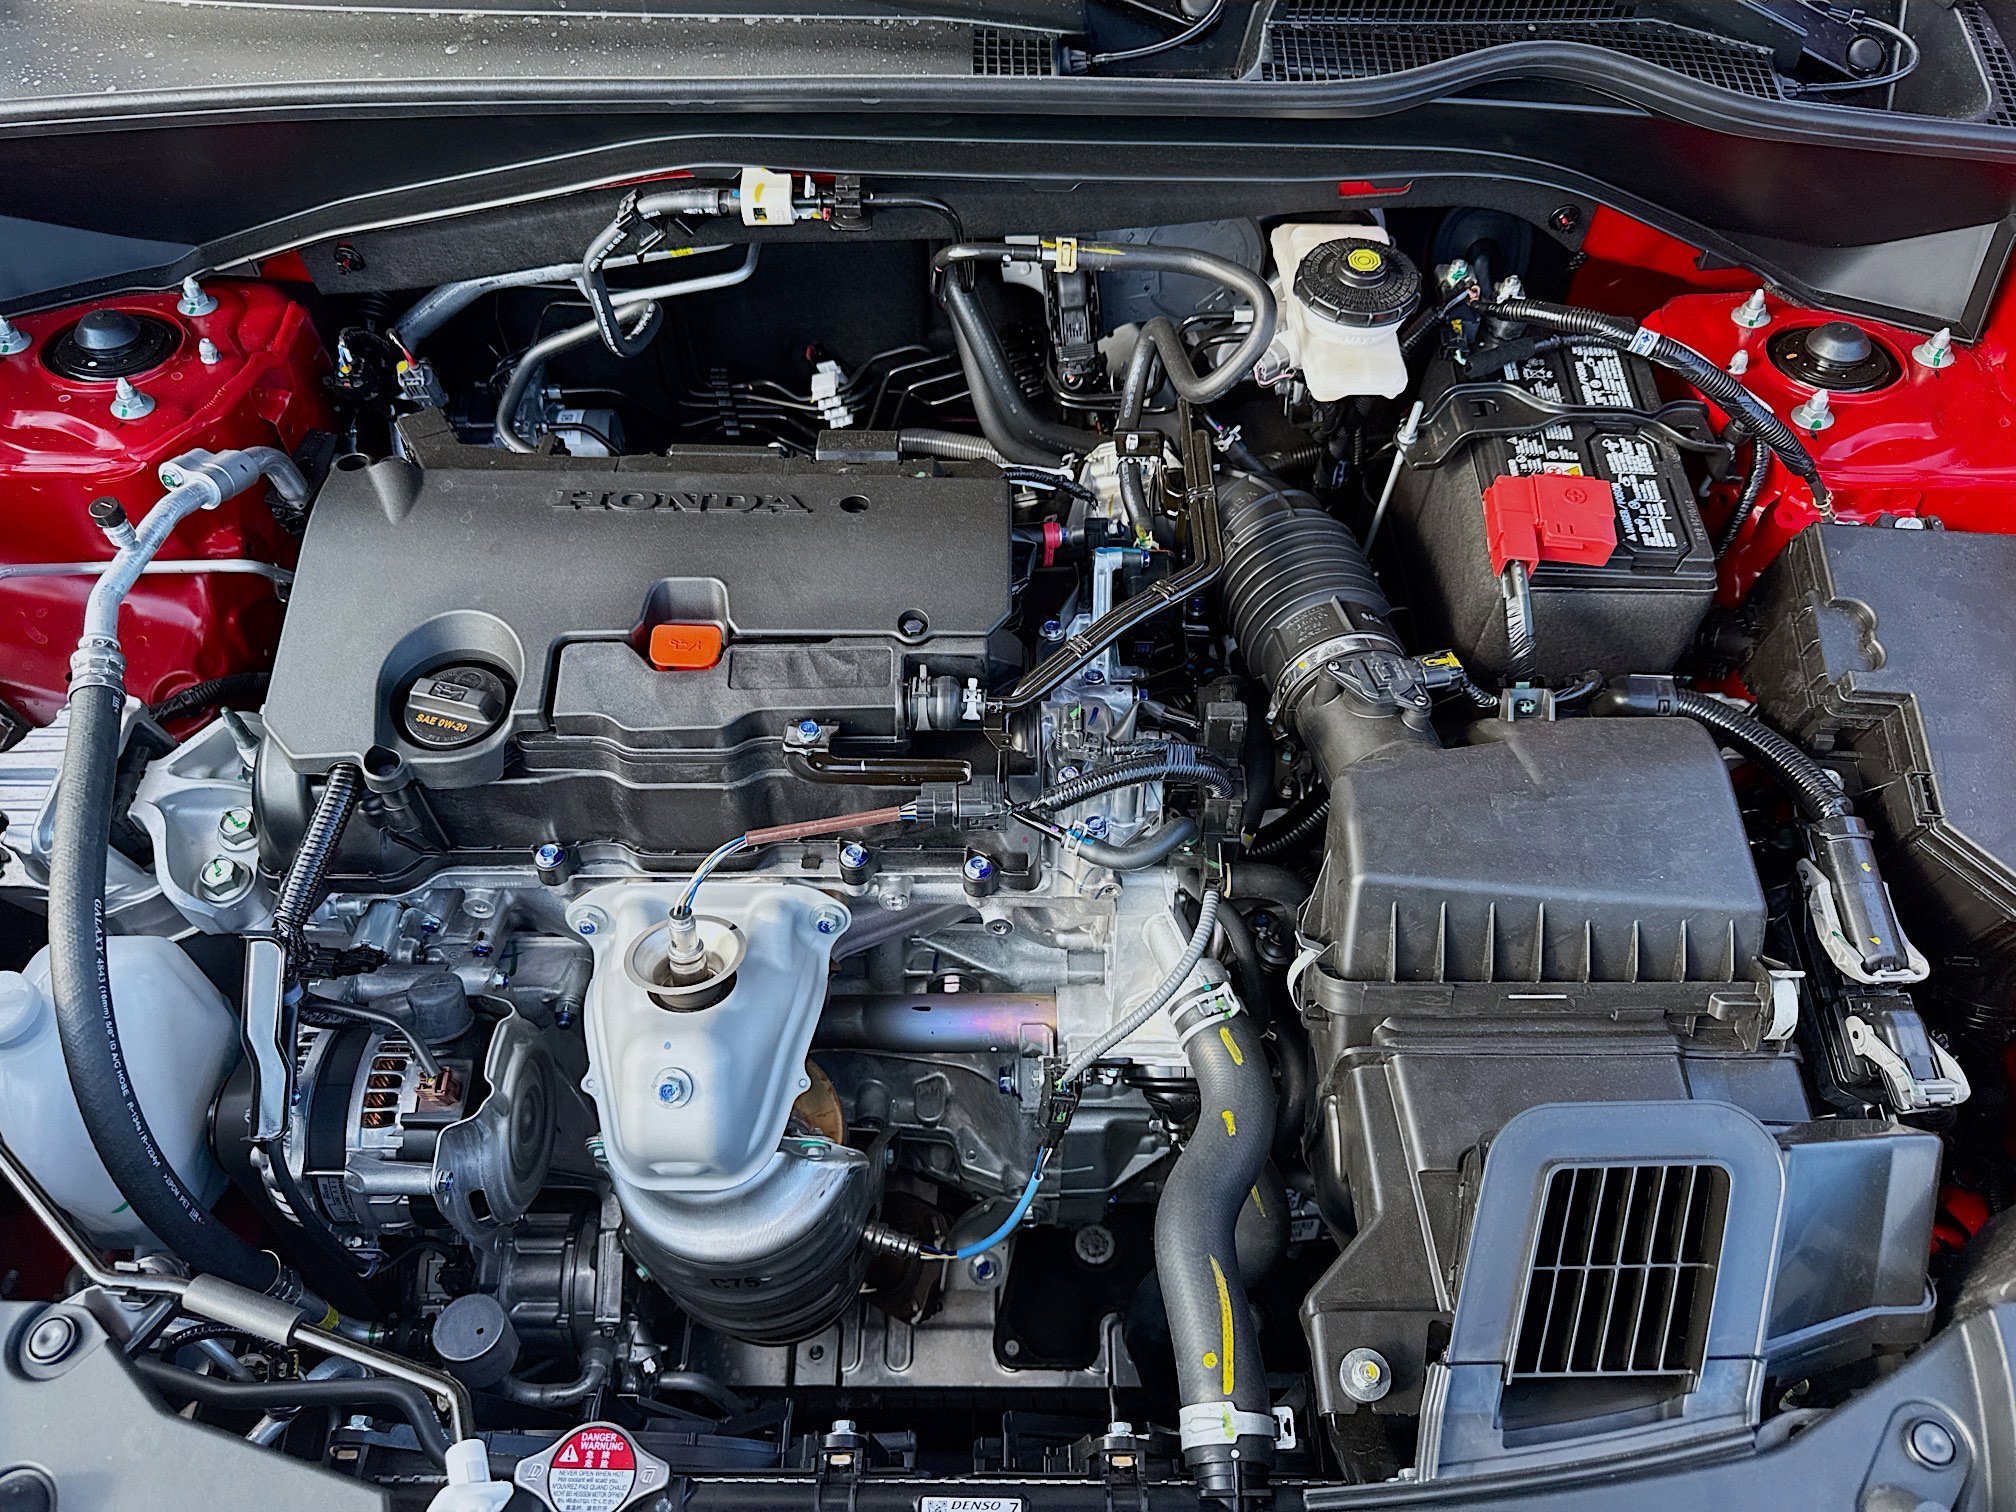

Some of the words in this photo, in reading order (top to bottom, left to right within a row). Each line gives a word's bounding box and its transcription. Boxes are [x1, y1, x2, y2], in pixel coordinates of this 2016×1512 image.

[551, 489, 814, 514] HONDA
[415, 713, 438, 726] SAE
[437, 718, 468, 733] 0W-20
[94, 898, 104, 956] GALAXY
[96, 957, 107, 983] 4843
[98, 985, 111, 1019] (16mm)
[116, 1069, 130, 1097] HOSE
[580, 1441, 624, 1451] WARNUNG
[581, 1432, 617, 1442] DANGER
[951, 1501, 1001, 1511] DENSO
